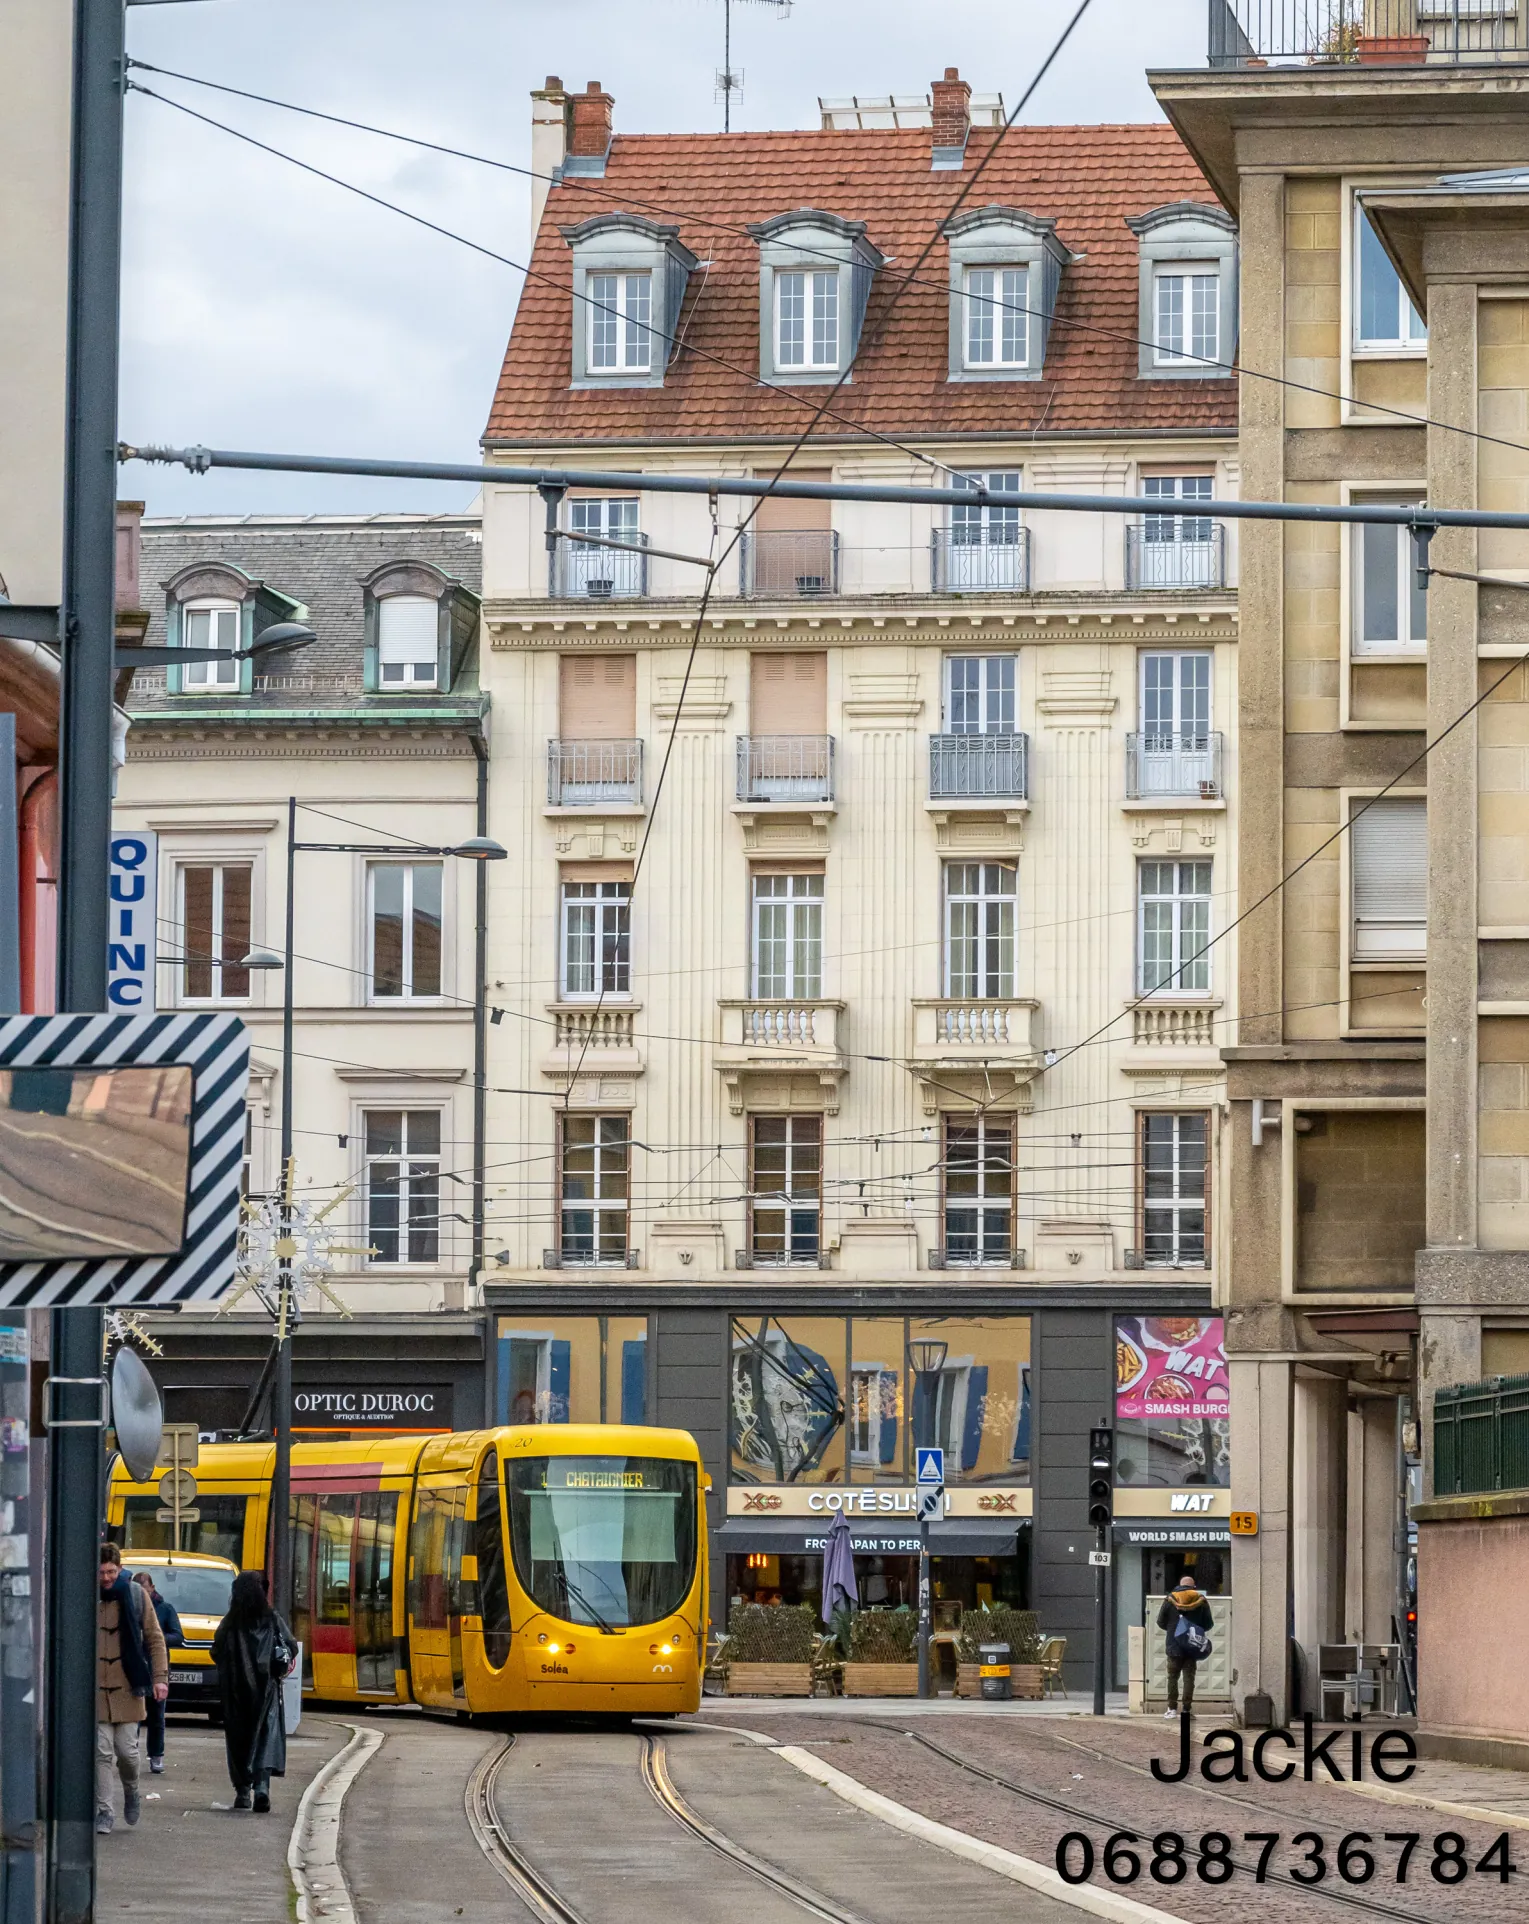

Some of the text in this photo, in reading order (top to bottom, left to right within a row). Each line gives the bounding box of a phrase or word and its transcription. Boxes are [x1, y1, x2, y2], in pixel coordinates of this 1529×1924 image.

[108, 838, 147, 1006] QUINC
[1165, 1349, 1225, 1380] WAT
[294, 1393, 434, 1411] OPTIC DUROC
[1145, 1403, 1230, 1415] SMASH BURG
[1170, 1494, 1214, 1511] WAT
[1235, 1516, 1253, 1530] 15
[1129, 1531, 1168, 1542] WORLD
[1169, 1531, 1208, 1542] SMASH
[805, 1538, 921, 1550] FRO APAN TO PER
[1094, 1554, 1108, 1563] 103
[541, 1660, 569, 1674] Soléa
